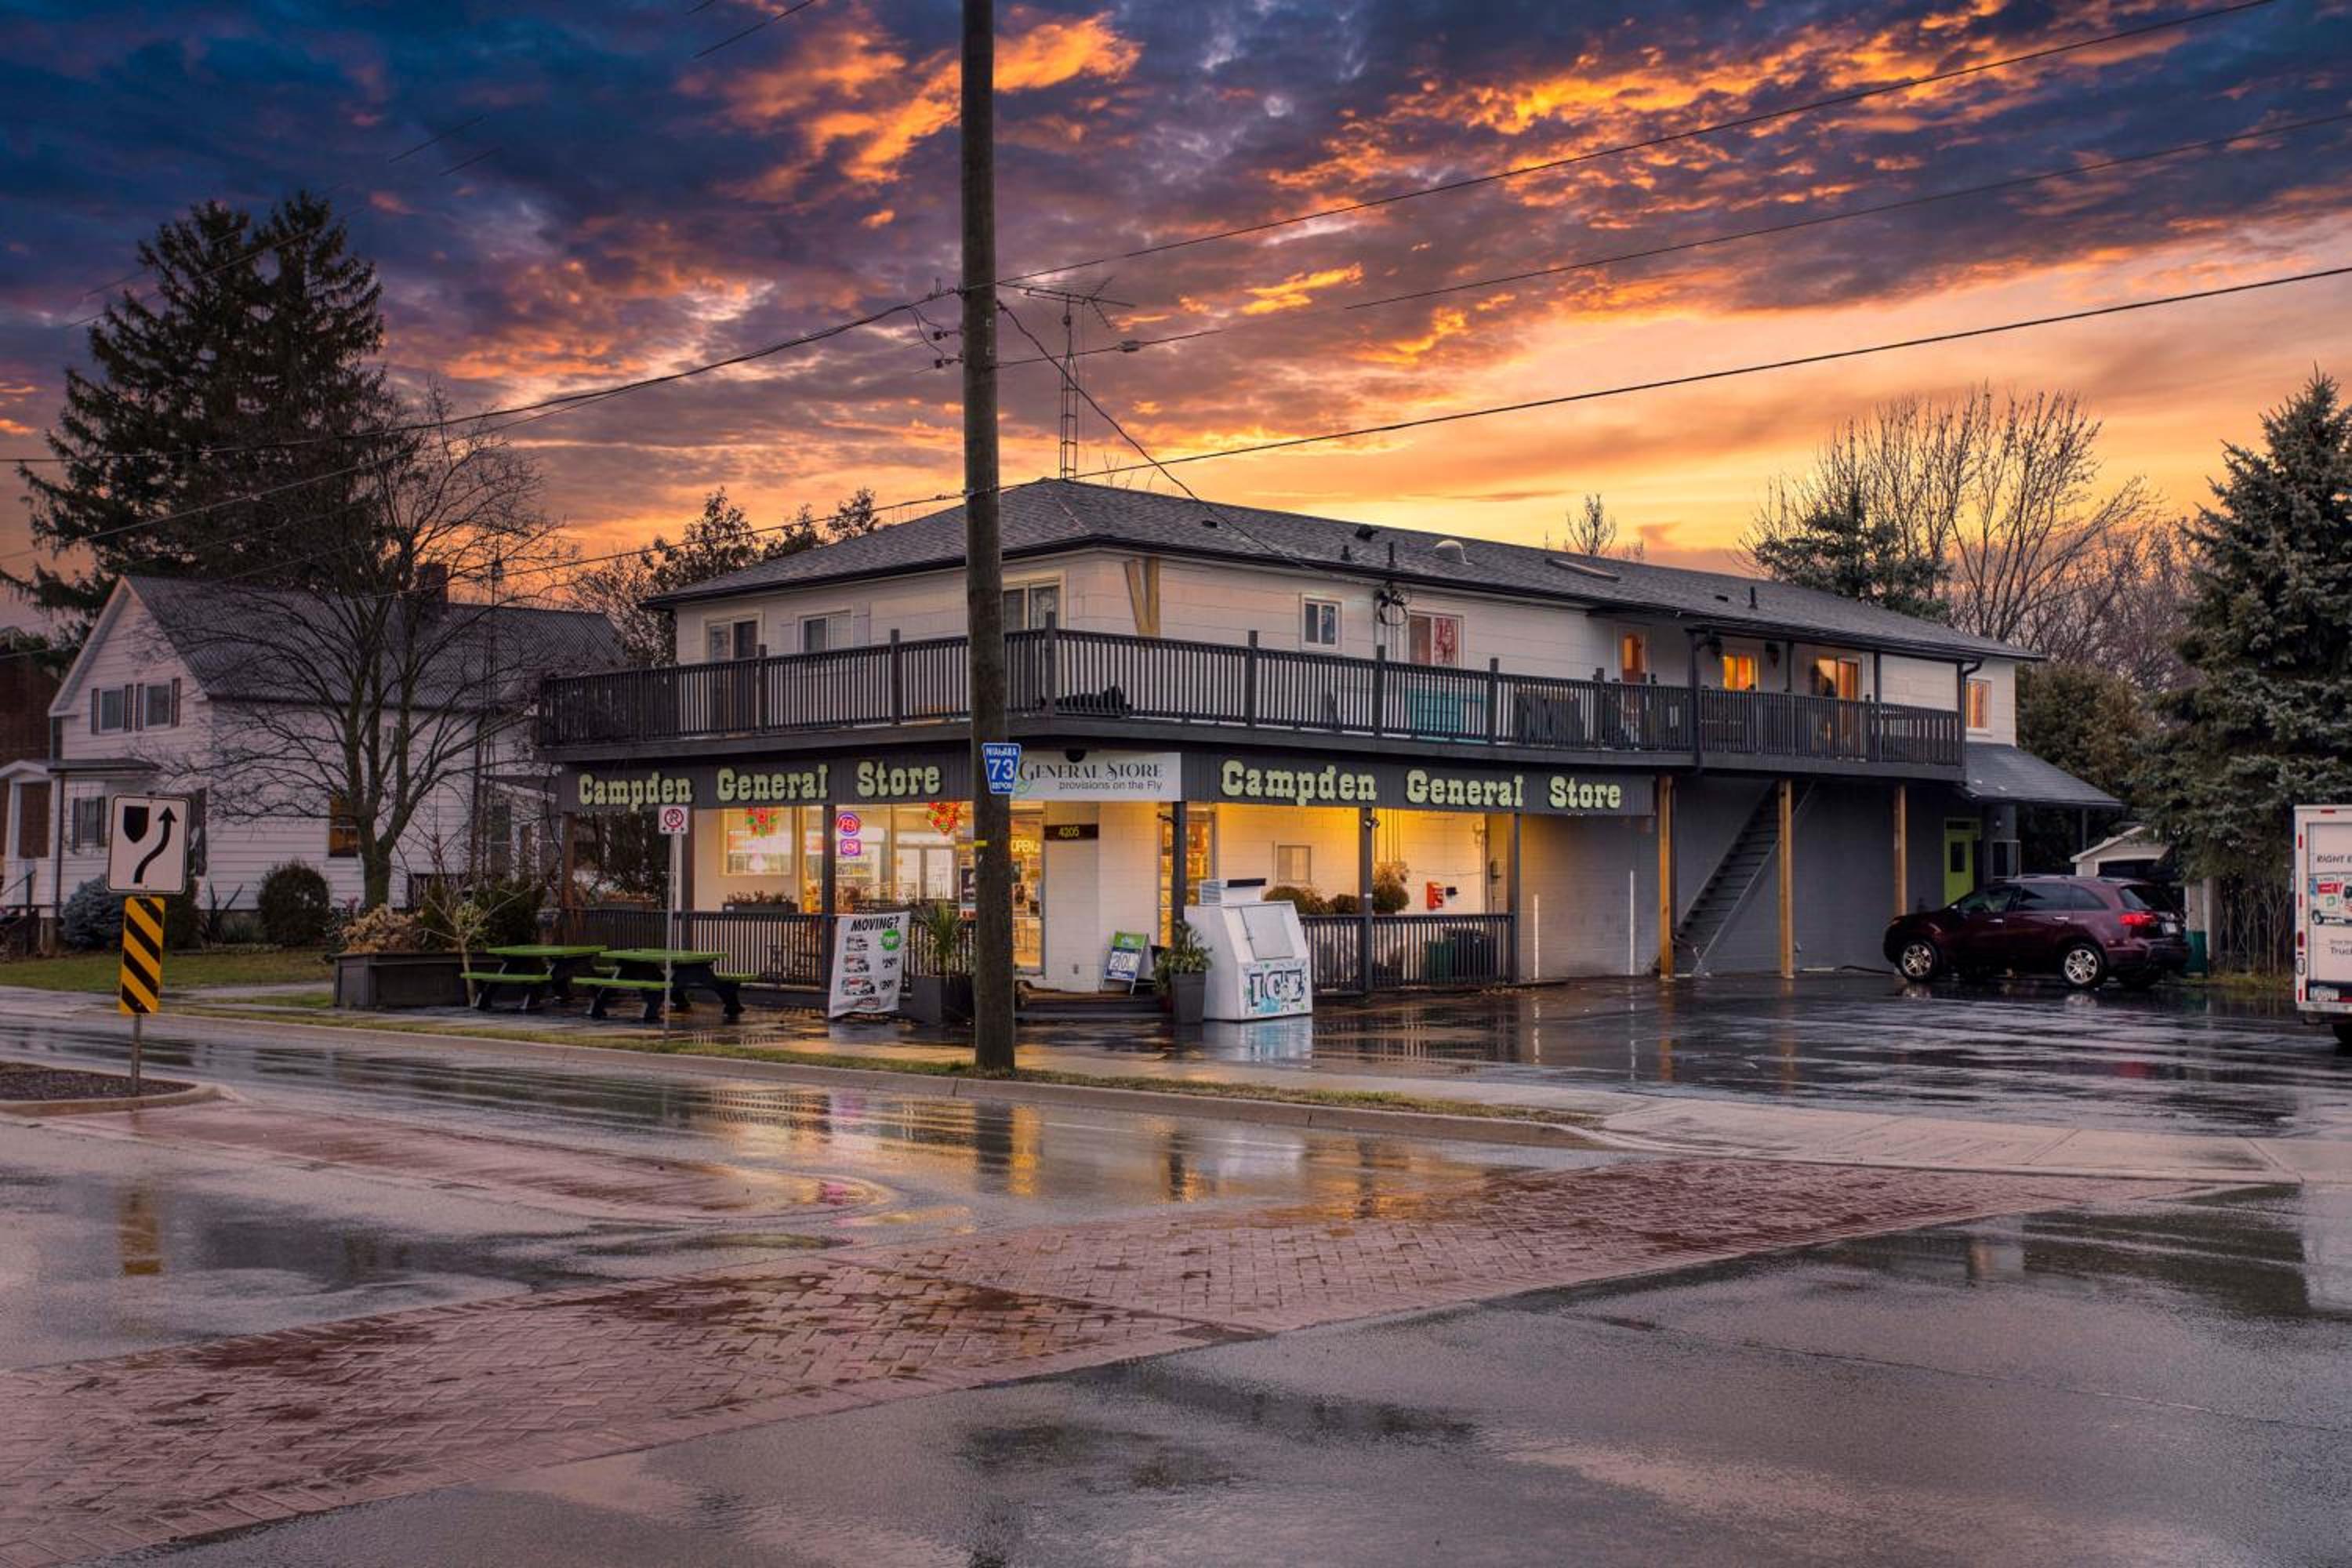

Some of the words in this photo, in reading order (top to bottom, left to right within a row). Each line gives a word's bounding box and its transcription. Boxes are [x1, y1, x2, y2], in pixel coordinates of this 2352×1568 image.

[989, 758, 1014, 780] 73
[1018, 760, 1099, 781] GENERAL
[1106, 760, 1163, 781] STORE
[579, 771, 692, 813] Campden
[717, 764, 829, 801] General
[857, 760, 941, 797] Store
[1058, 781, 1110, 790] provisions
[1112, 782, 1127, 790] on
[1127, 781, 1145, 790] the
[1147, 781, 1163, 792] Fly
[1221, 759, 1377, 806] Campden
[1406, 769, 1524, 807] General
[1548, 775, 1621, 808] Store
[1011, 840, 1036, 854] OPEN
[2317, 854, 2345, 863] RIGHT
[851, 916, 900, 932] MOVING?
[1250, 968, 1305, 1007] ICE
